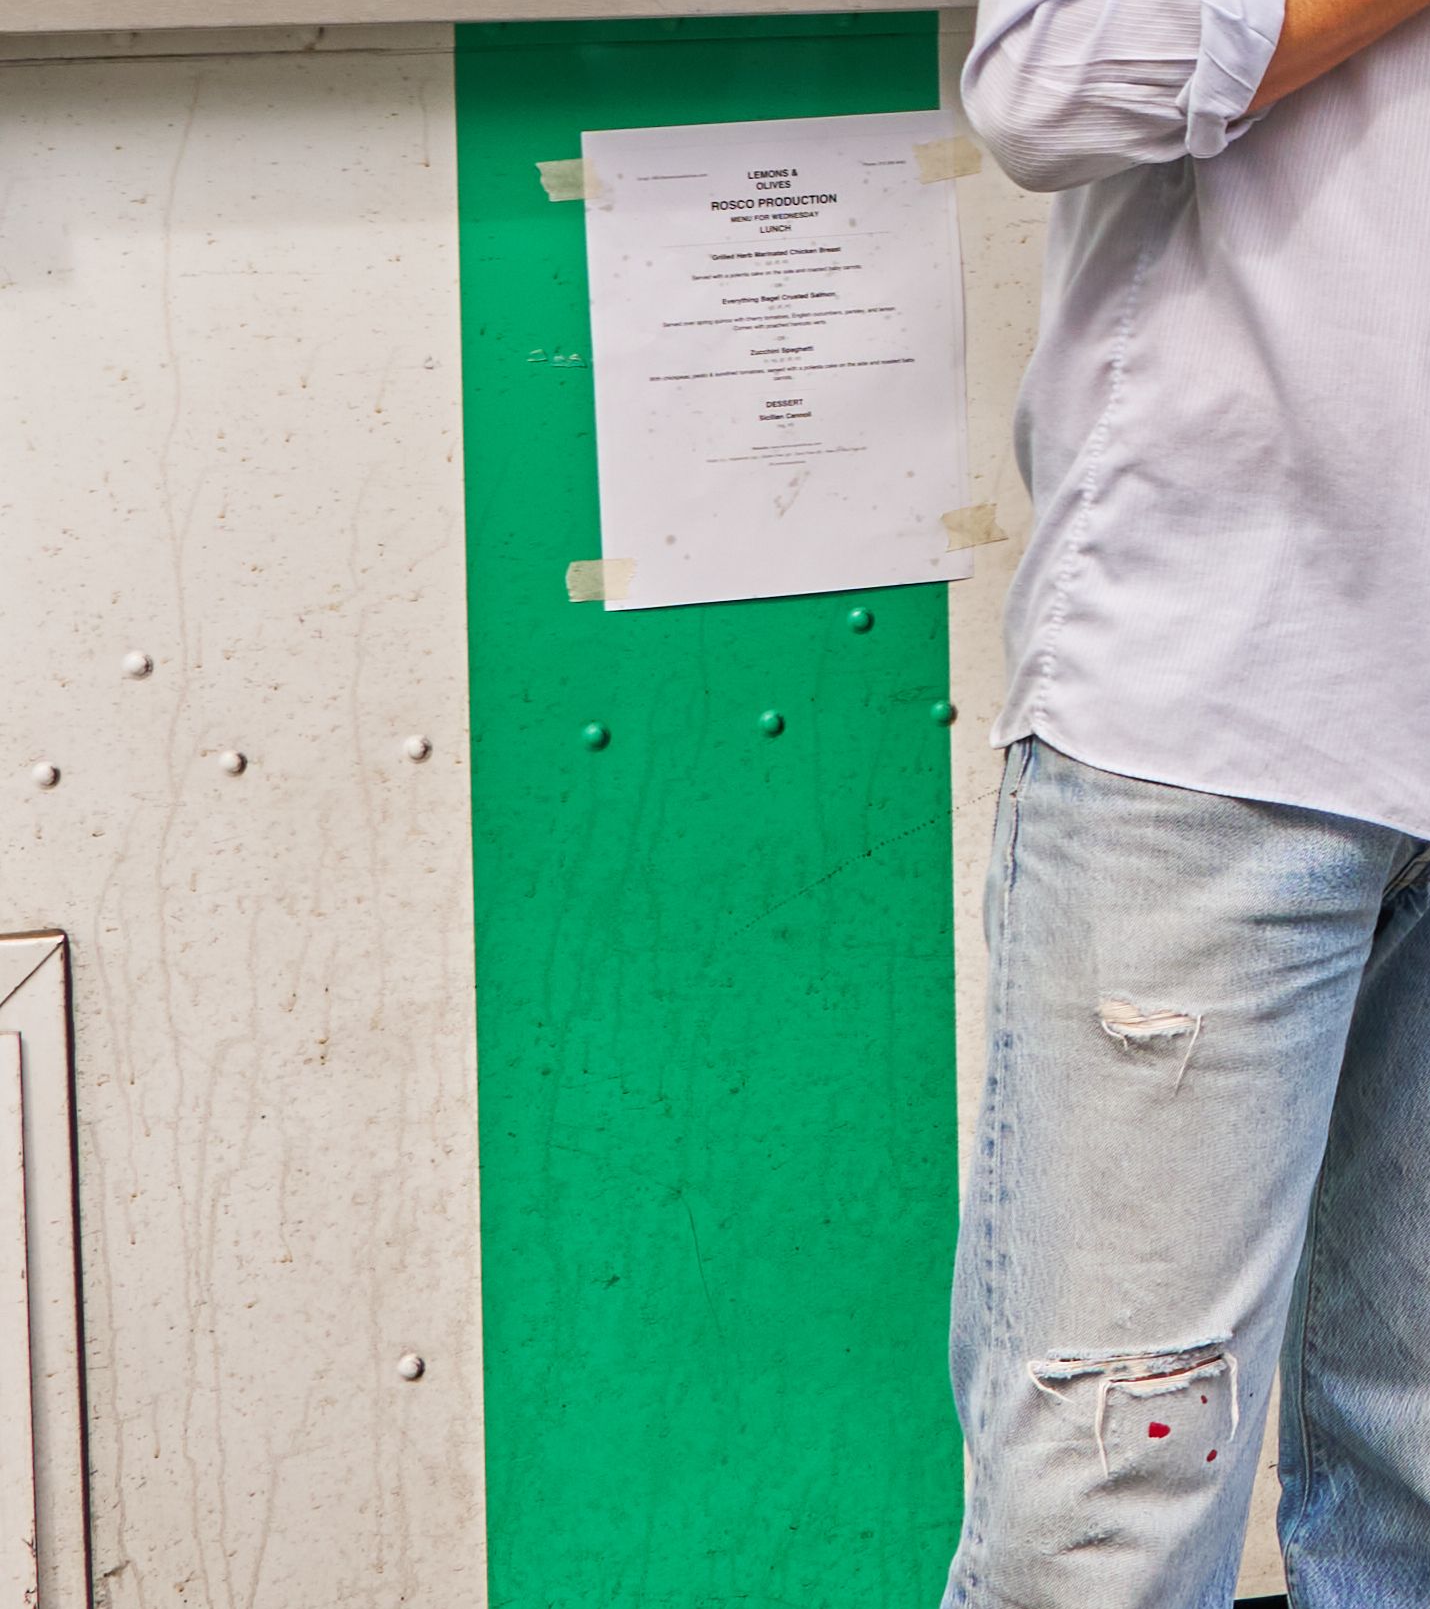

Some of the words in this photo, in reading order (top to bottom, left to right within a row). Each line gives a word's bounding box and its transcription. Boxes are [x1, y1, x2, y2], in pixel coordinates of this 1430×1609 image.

[747, 169, 788, 180] LEMONS
[791, 168, 798, 177] &
[756, 180, 791, 191] OLIVES
[711, 199, 755, 211] ROSCO
[758, 193, 837, 208] PRODUCTION
[731, 215, 752, 223] MENU
[771, 211, 819, 220] WEDNESDAY
[760, 224, 791, 234] LUNCH
[766, 398, 803, 408] DESSERT
